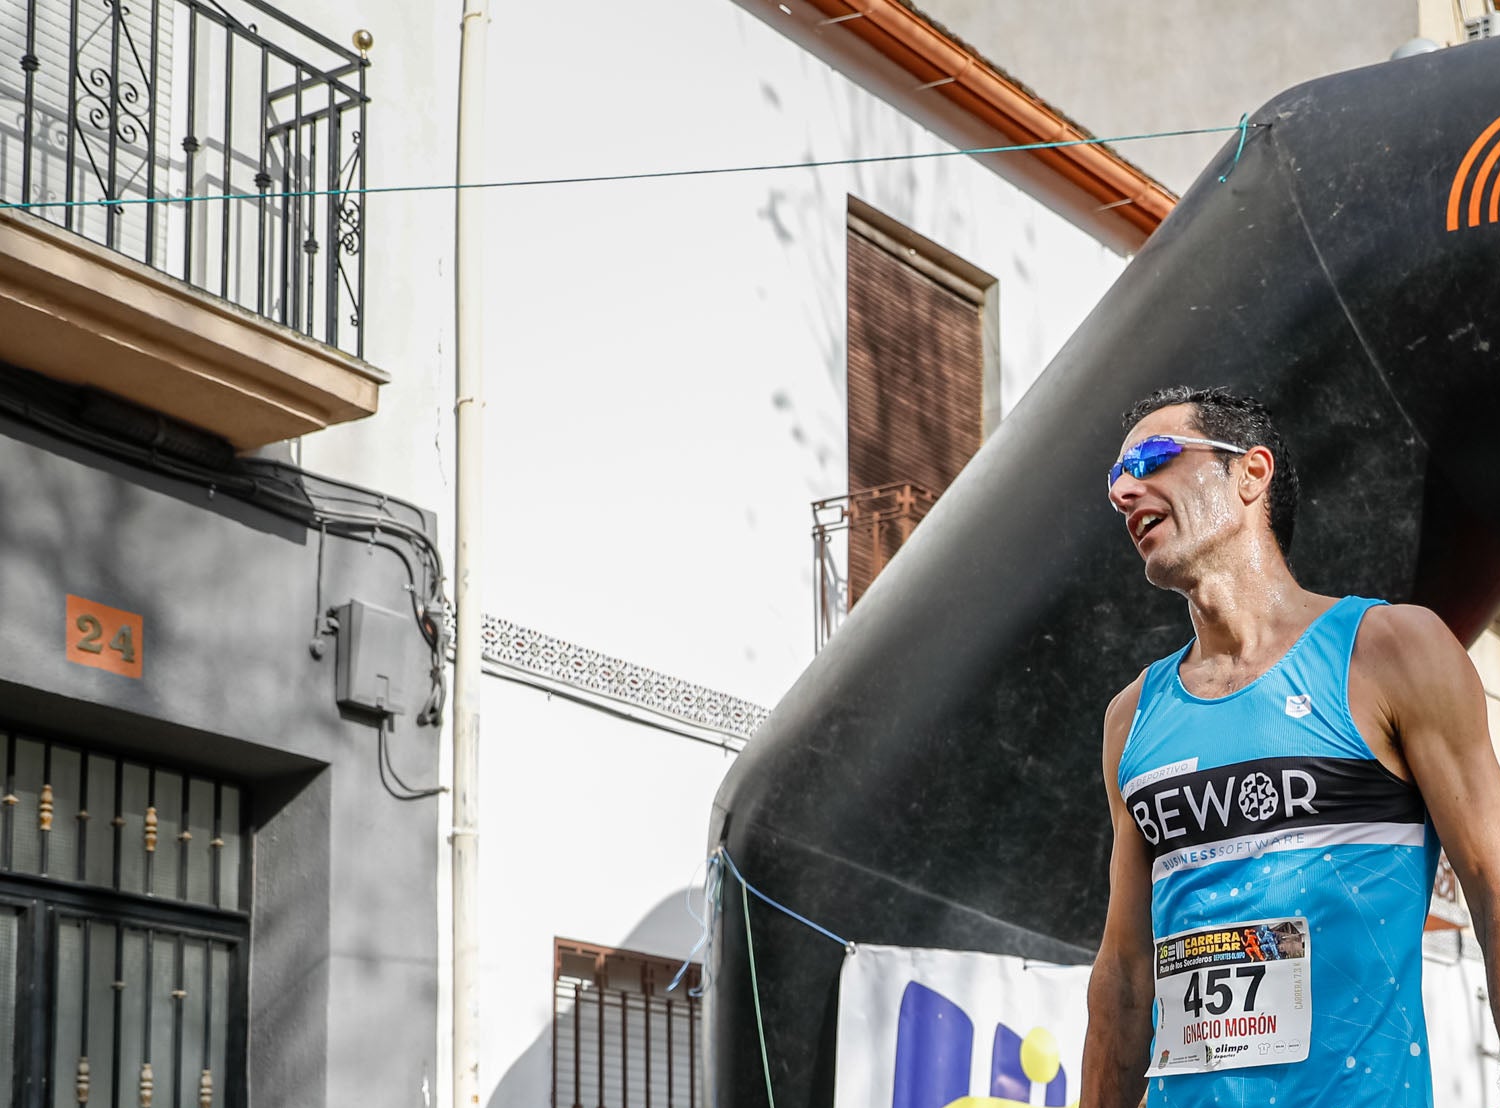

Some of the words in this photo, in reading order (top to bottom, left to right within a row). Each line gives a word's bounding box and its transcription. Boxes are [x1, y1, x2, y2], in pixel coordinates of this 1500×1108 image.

[76, 614, 136, 664] 24
[1184, 931, 1241, 949] CARRERA
[1185, 942, 1241, 958] POPULAR
[1183, 955, 1213, 968] Secaderos
[1183, 964, 1266, 1018] 457
[1183, 1019, 1222, 1045] IGNACIO
[1224, 1012, 1278, 1038] MORÓN
[1215, 1043, 1249, 1054] olimpo
